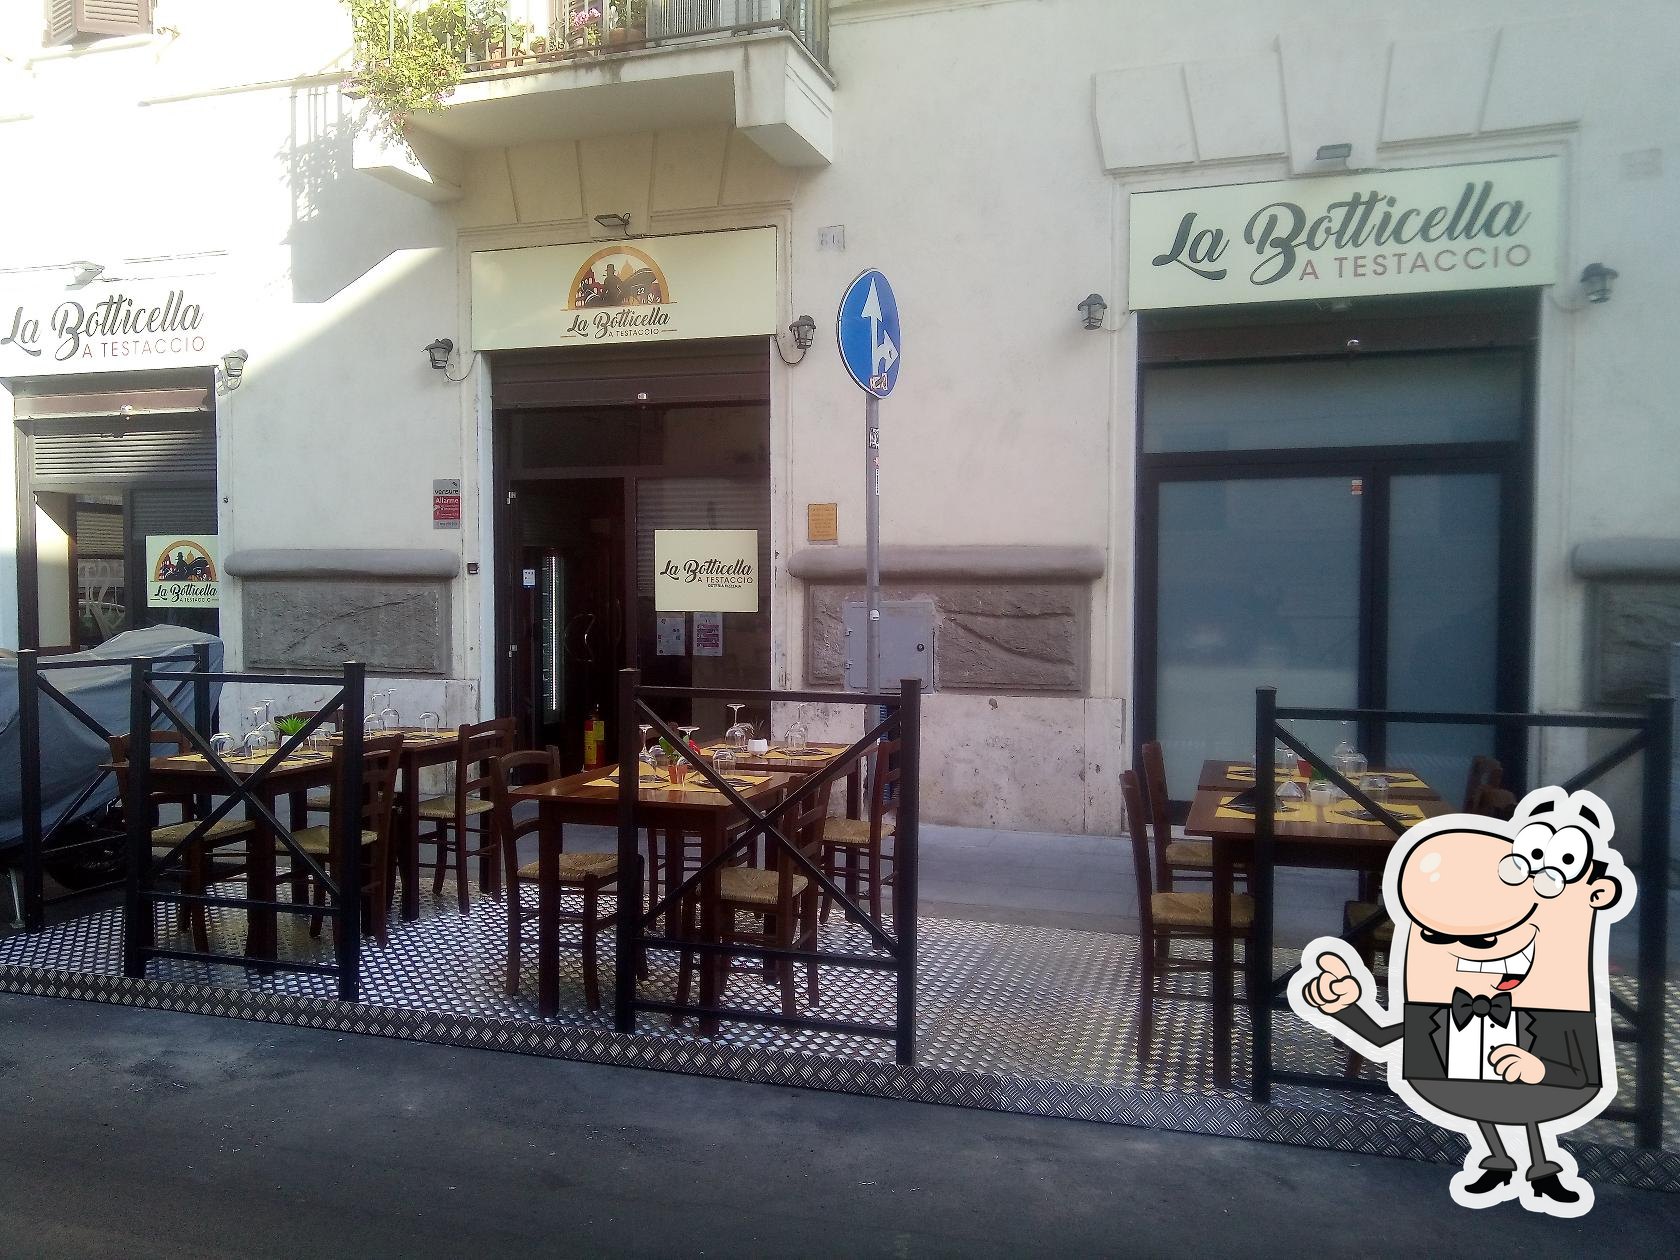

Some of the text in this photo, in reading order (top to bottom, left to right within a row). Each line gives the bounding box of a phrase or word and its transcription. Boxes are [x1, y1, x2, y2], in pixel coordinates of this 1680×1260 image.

[1151, 179, 1532, 286] La Botticella
[1298, 243, 1532, 281] A TESTACCIO
[0, 289, 205, 362] La Botticella
[566, 306, 670, 339] La Botticella
[615, 328, 660, 337] TESTACCIO
[82, 335, 205, 359] A TESTACCIO
[659, 558, 753, 584] La Botticella
[705, 576, 754, 584] TESTACCIO
[154, 583, 217, 602] La Botticella
